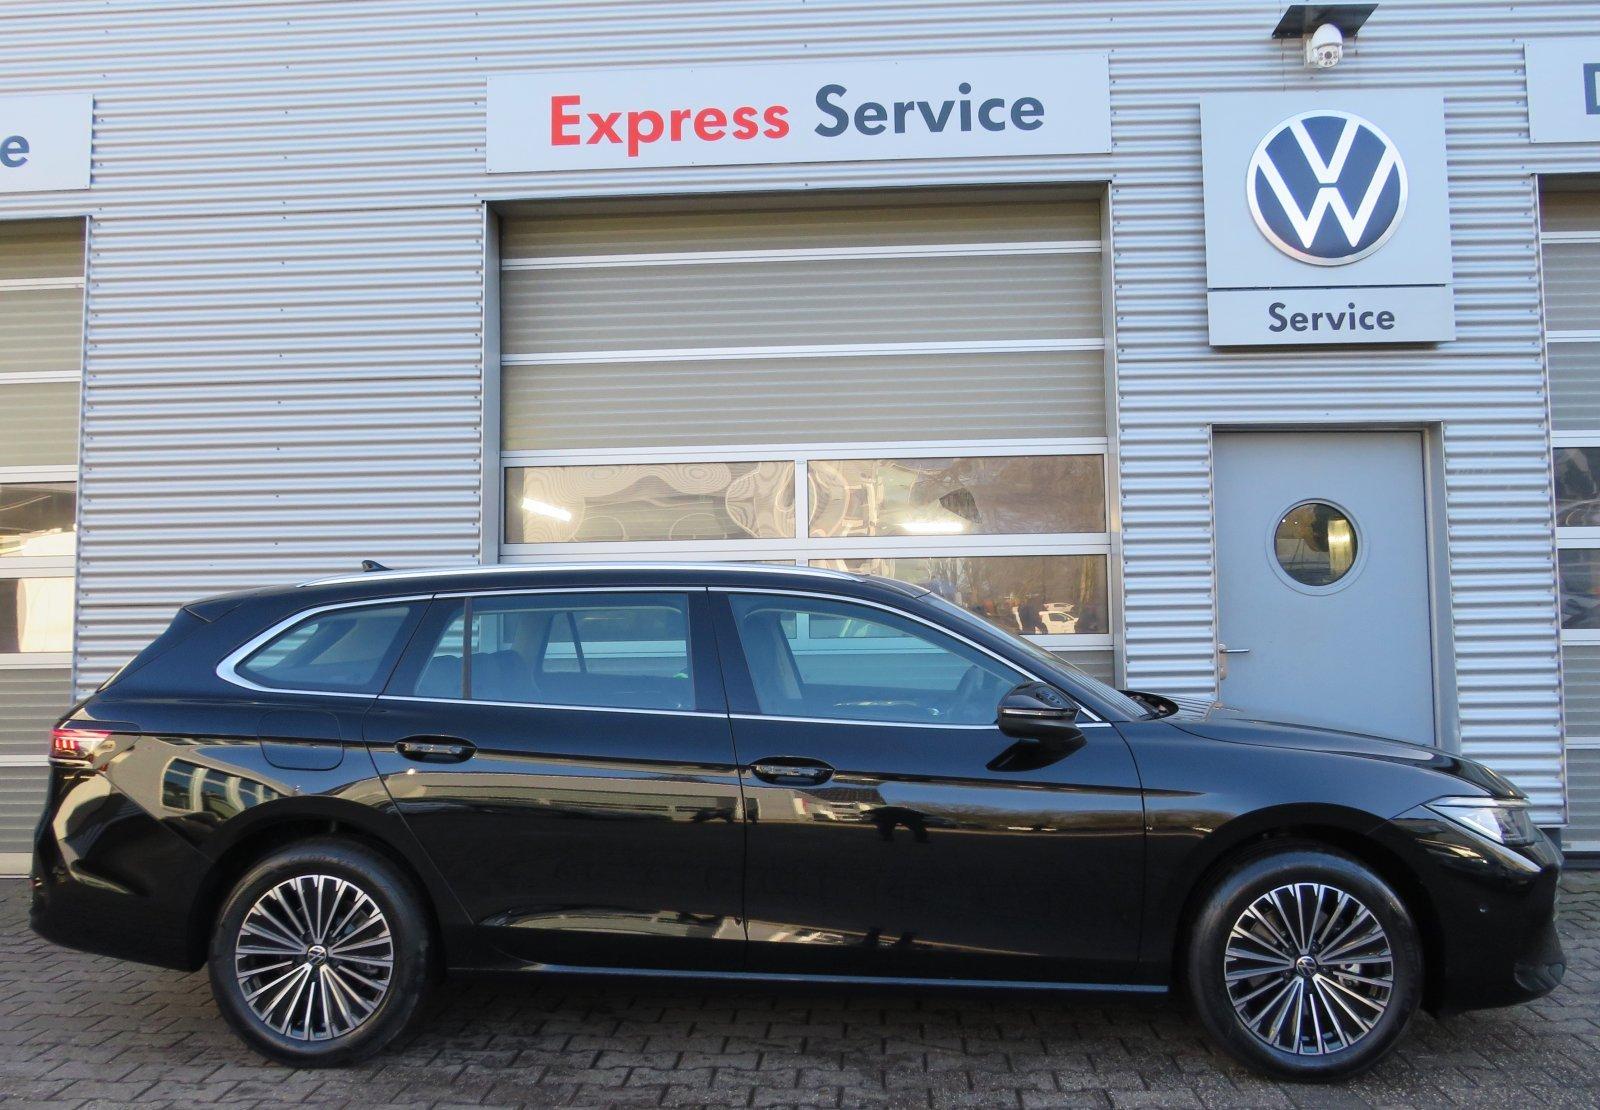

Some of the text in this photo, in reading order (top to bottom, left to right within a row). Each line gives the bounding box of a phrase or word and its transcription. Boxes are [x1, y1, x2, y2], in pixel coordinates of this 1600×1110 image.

[551, 82, 1045, 158] Express Service
[1249, 113, 1405, 250] VW
[1268, 301, 1396, 333] Service
